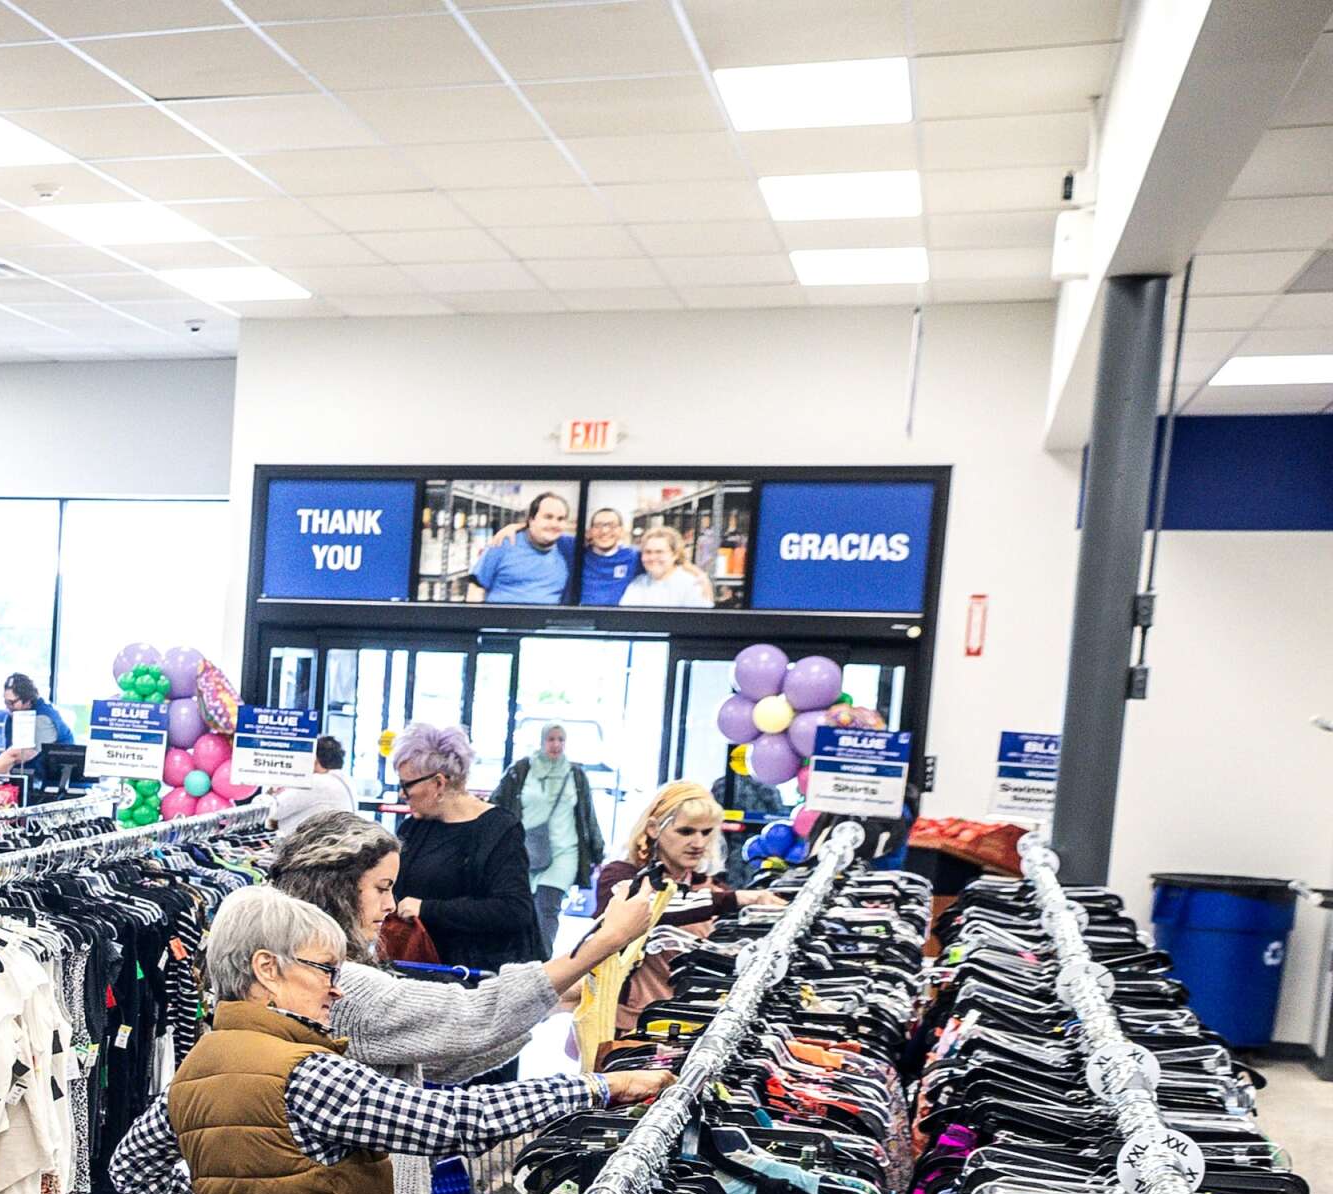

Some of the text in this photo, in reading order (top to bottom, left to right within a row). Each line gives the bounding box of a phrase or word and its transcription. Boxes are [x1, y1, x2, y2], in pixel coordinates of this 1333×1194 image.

[569, 421, 609, 448] EXIT
[296, 508, 382, 535] THANK
[779, 532, 910, 562] GRACIAS
[311, 544, 362, 571] YOU
[111, 708, 149, 720] BLUE
[258, 714, 298, 726] BLUE
[839, 736, 887, 750] BLUE
[1024, 741, 1059, 754] BLU
[106, 750, 143, 760] Shirts
[253, 758, 293, 769] Shirts
[1161, 1134, 1189, 1157] XXL
[1123, 1143, 1149, 1168] XXL
